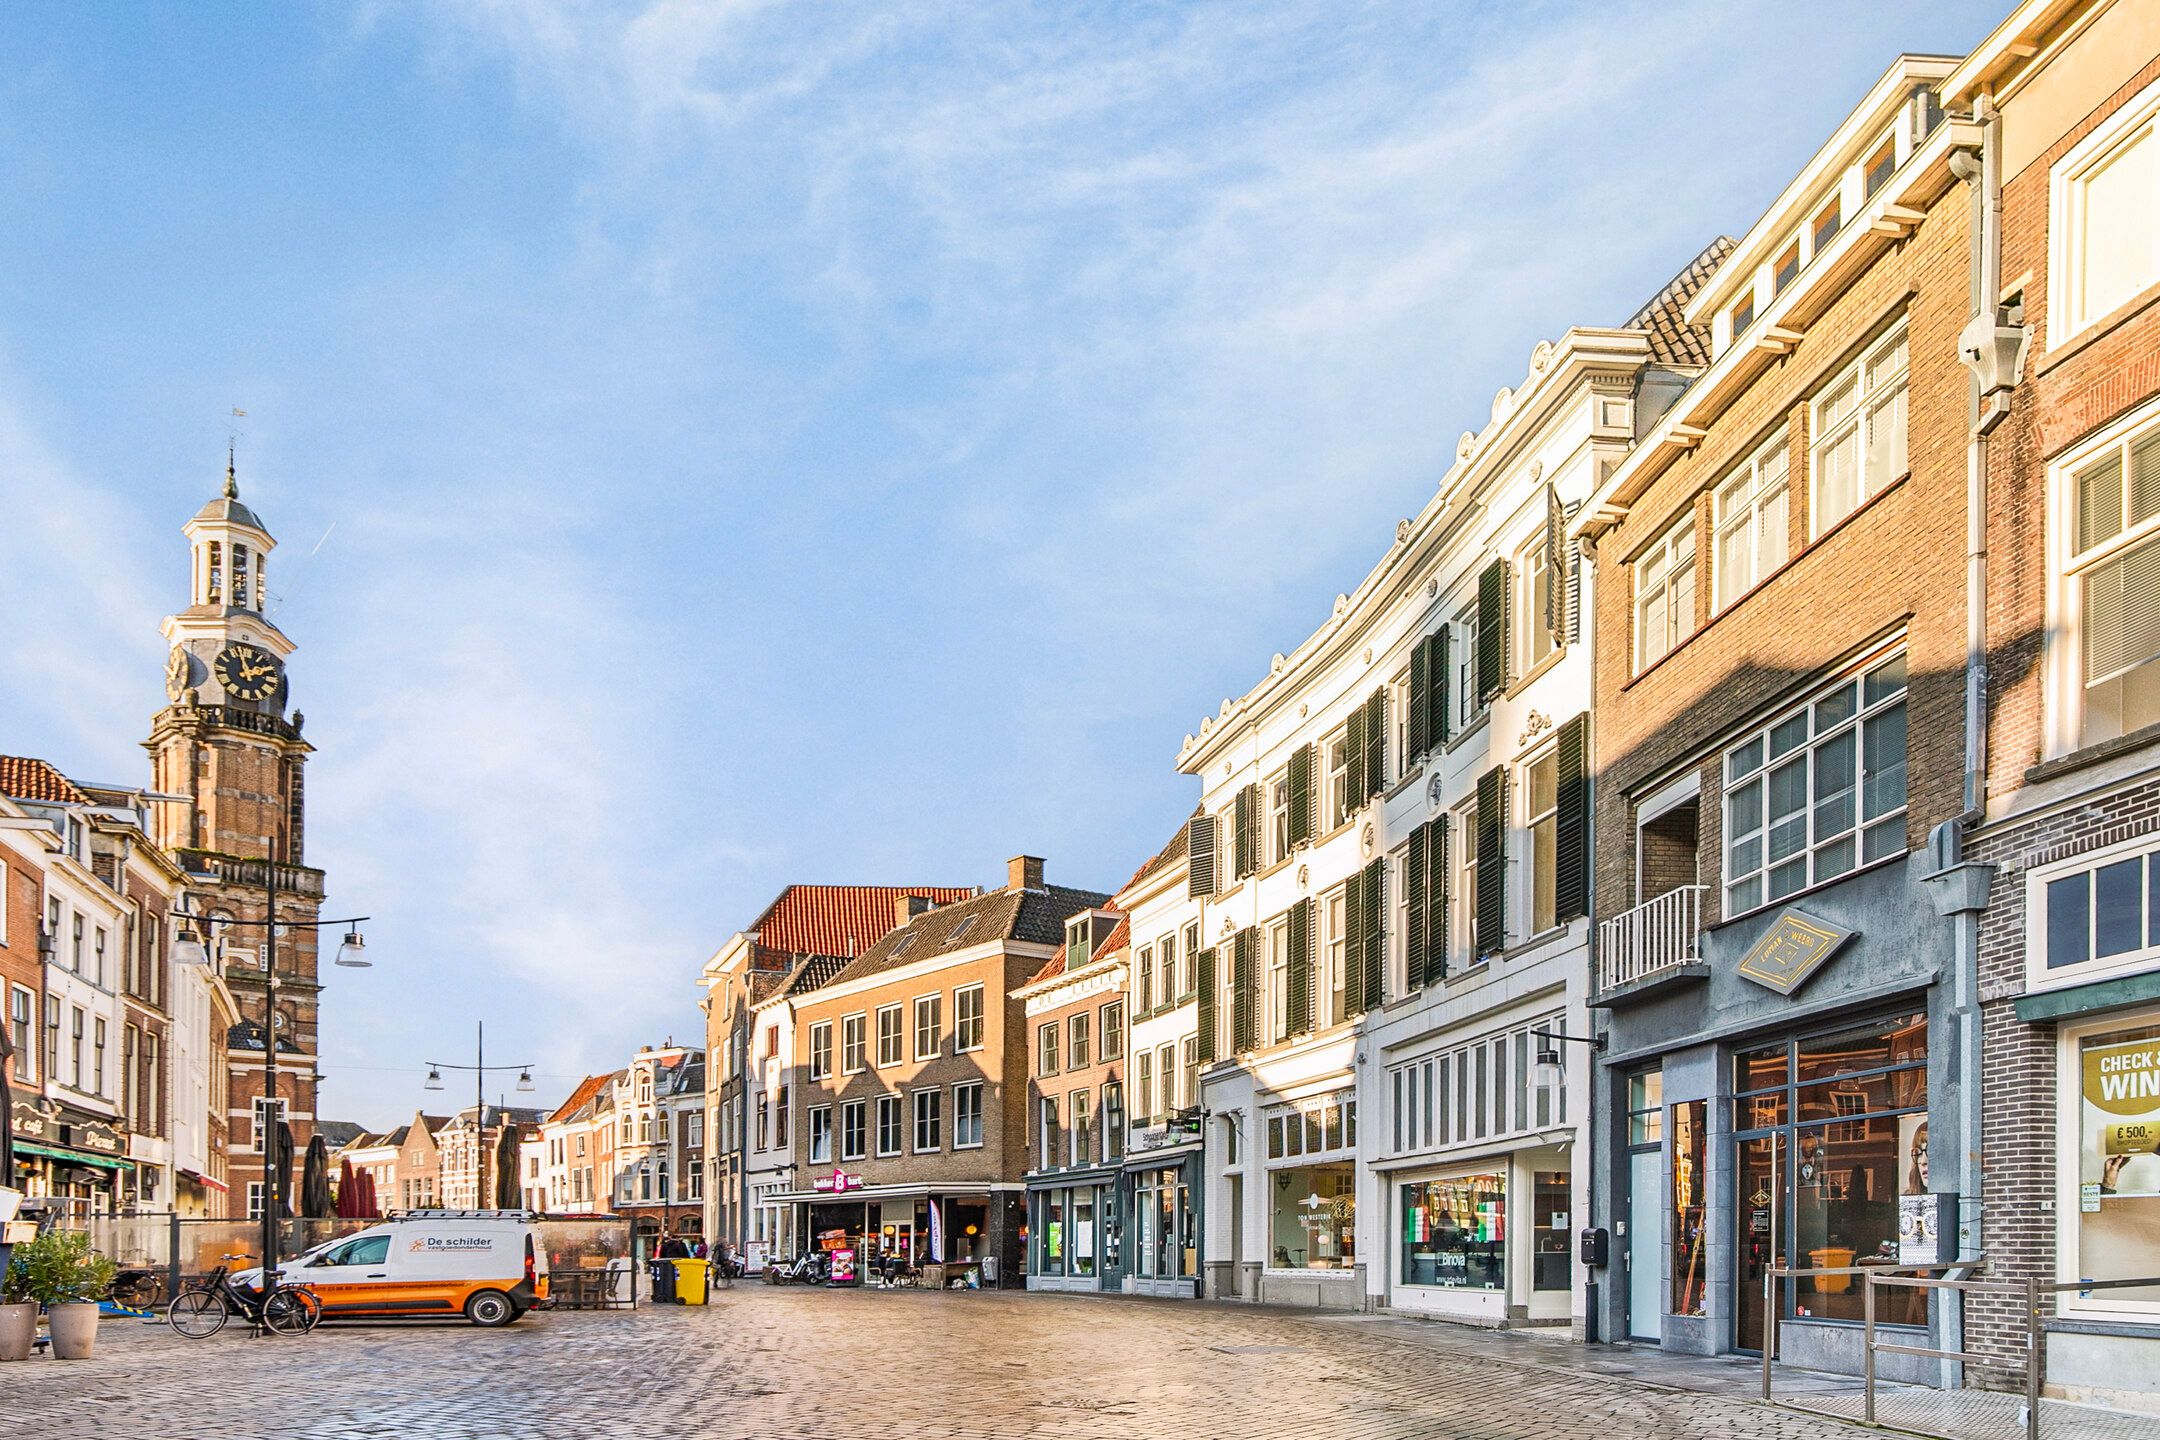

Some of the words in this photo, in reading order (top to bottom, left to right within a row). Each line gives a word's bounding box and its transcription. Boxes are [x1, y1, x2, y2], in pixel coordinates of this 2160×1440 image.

[2101, 1052, 2153, 1073] CHECK
[2101, 1070, 2160, 1101] WIN
[2117, 1128, 2123, 1139] €
[2126, 1126, 2153, 1139] 500,-
[428, 1238, 442, 1246] De
[446, 1237, 492, 1246] schilder
[1442, 1252, 1466, 1267] Binova
